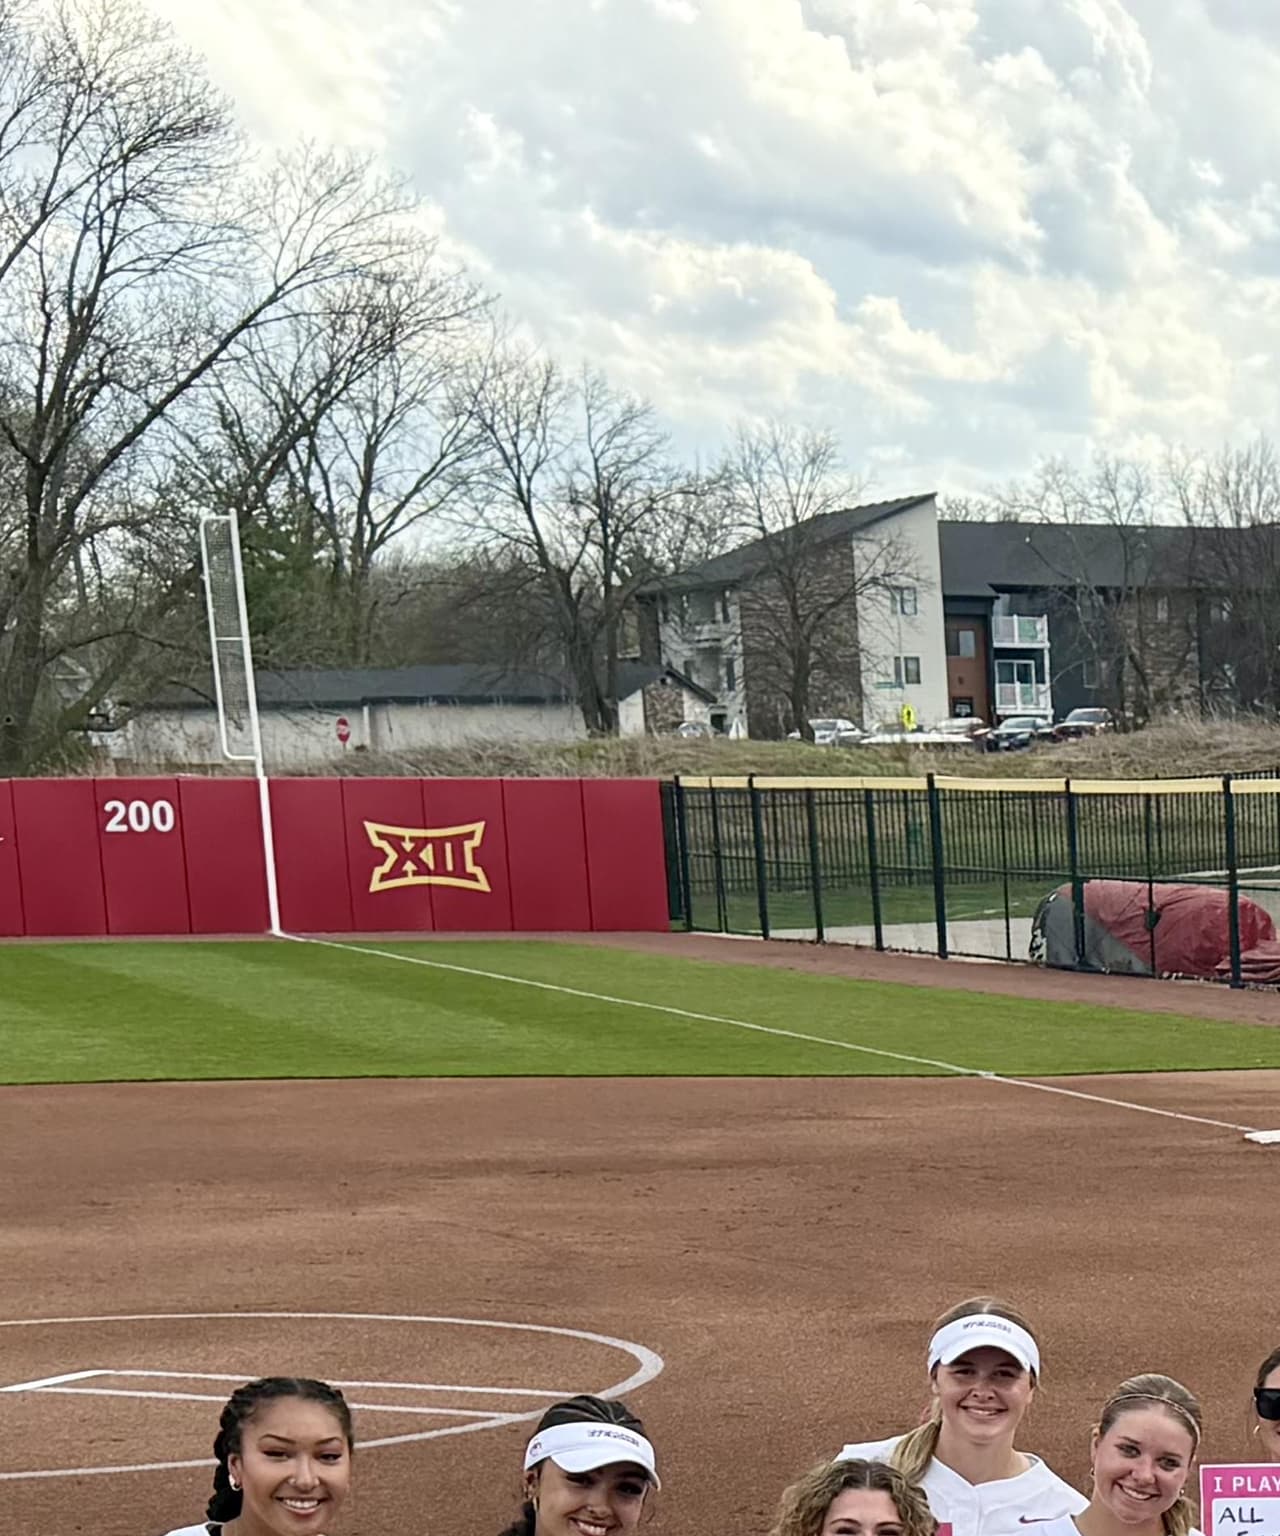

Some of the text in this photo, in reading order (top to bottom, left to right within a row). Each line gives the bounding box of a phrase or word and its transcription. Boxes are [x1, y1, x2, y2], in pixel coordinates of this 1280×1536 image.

[104, 800, 174, 832] 200
[1214, 1476, 1222, 1492] I
[1219, 1507, 1264, 1524] ALL
